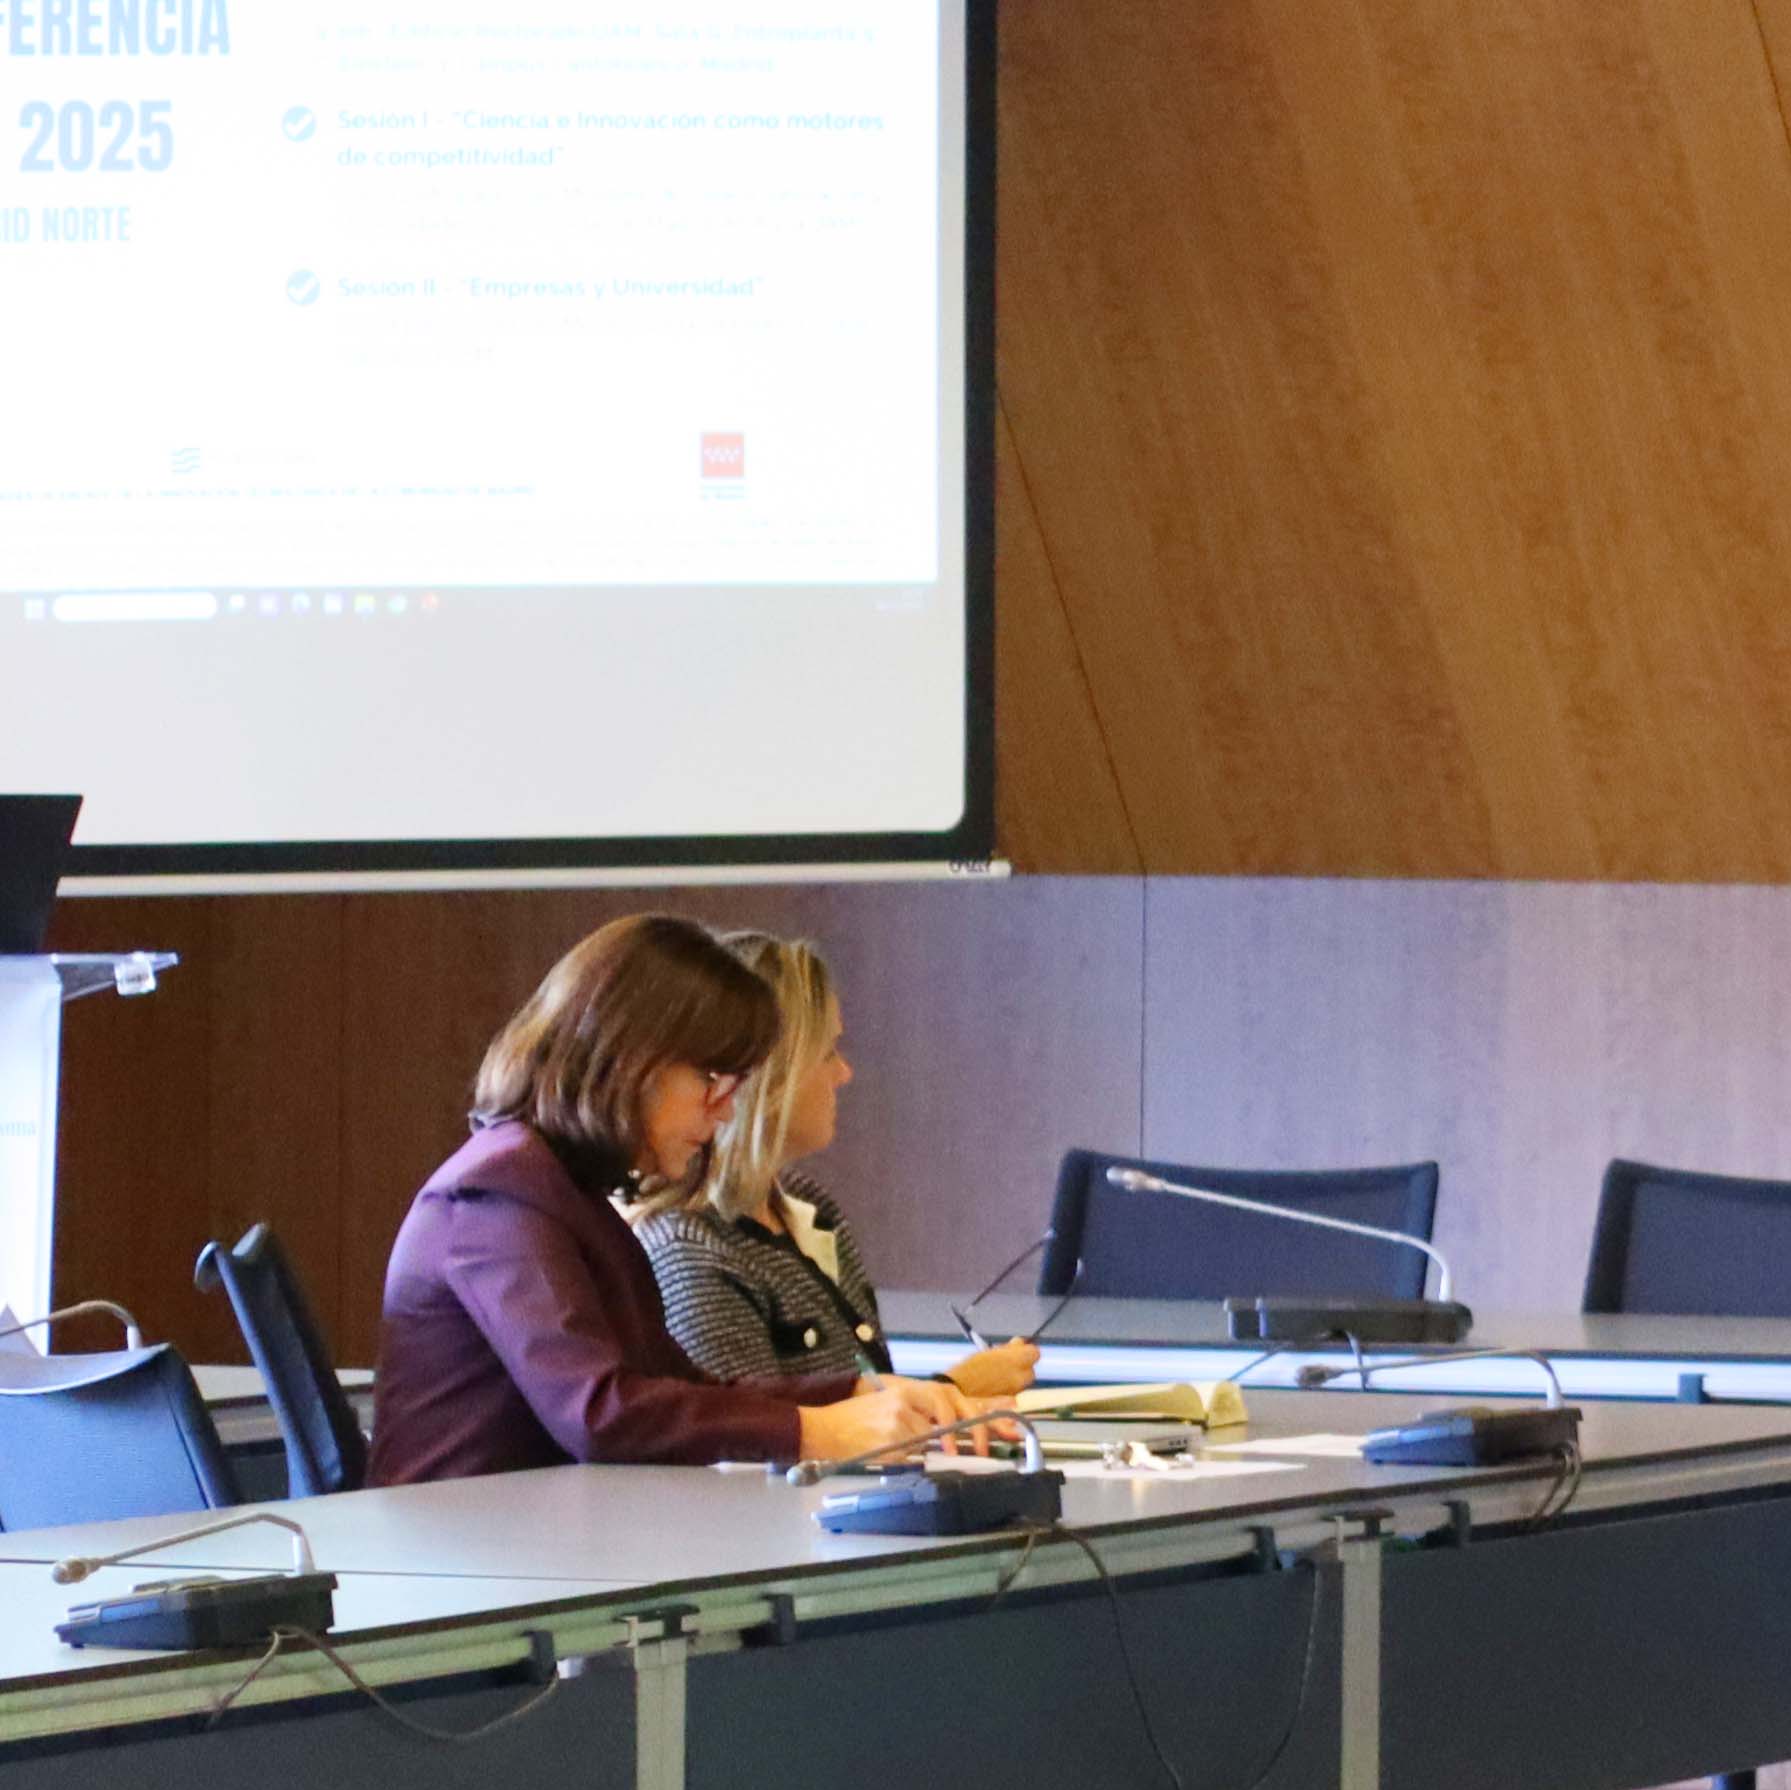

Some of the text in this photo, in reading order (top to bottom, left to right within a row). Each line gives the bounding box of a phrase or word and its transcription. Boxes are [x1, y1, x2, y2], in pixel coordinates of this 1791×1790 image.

[0, 0, 230, 55] ERENCIA
[19, 100, 174, 172] 2025
[713, 112, 781, 129] como
[336, 145, 369, 162] de
[42, 206, 130, 241] NORTE
